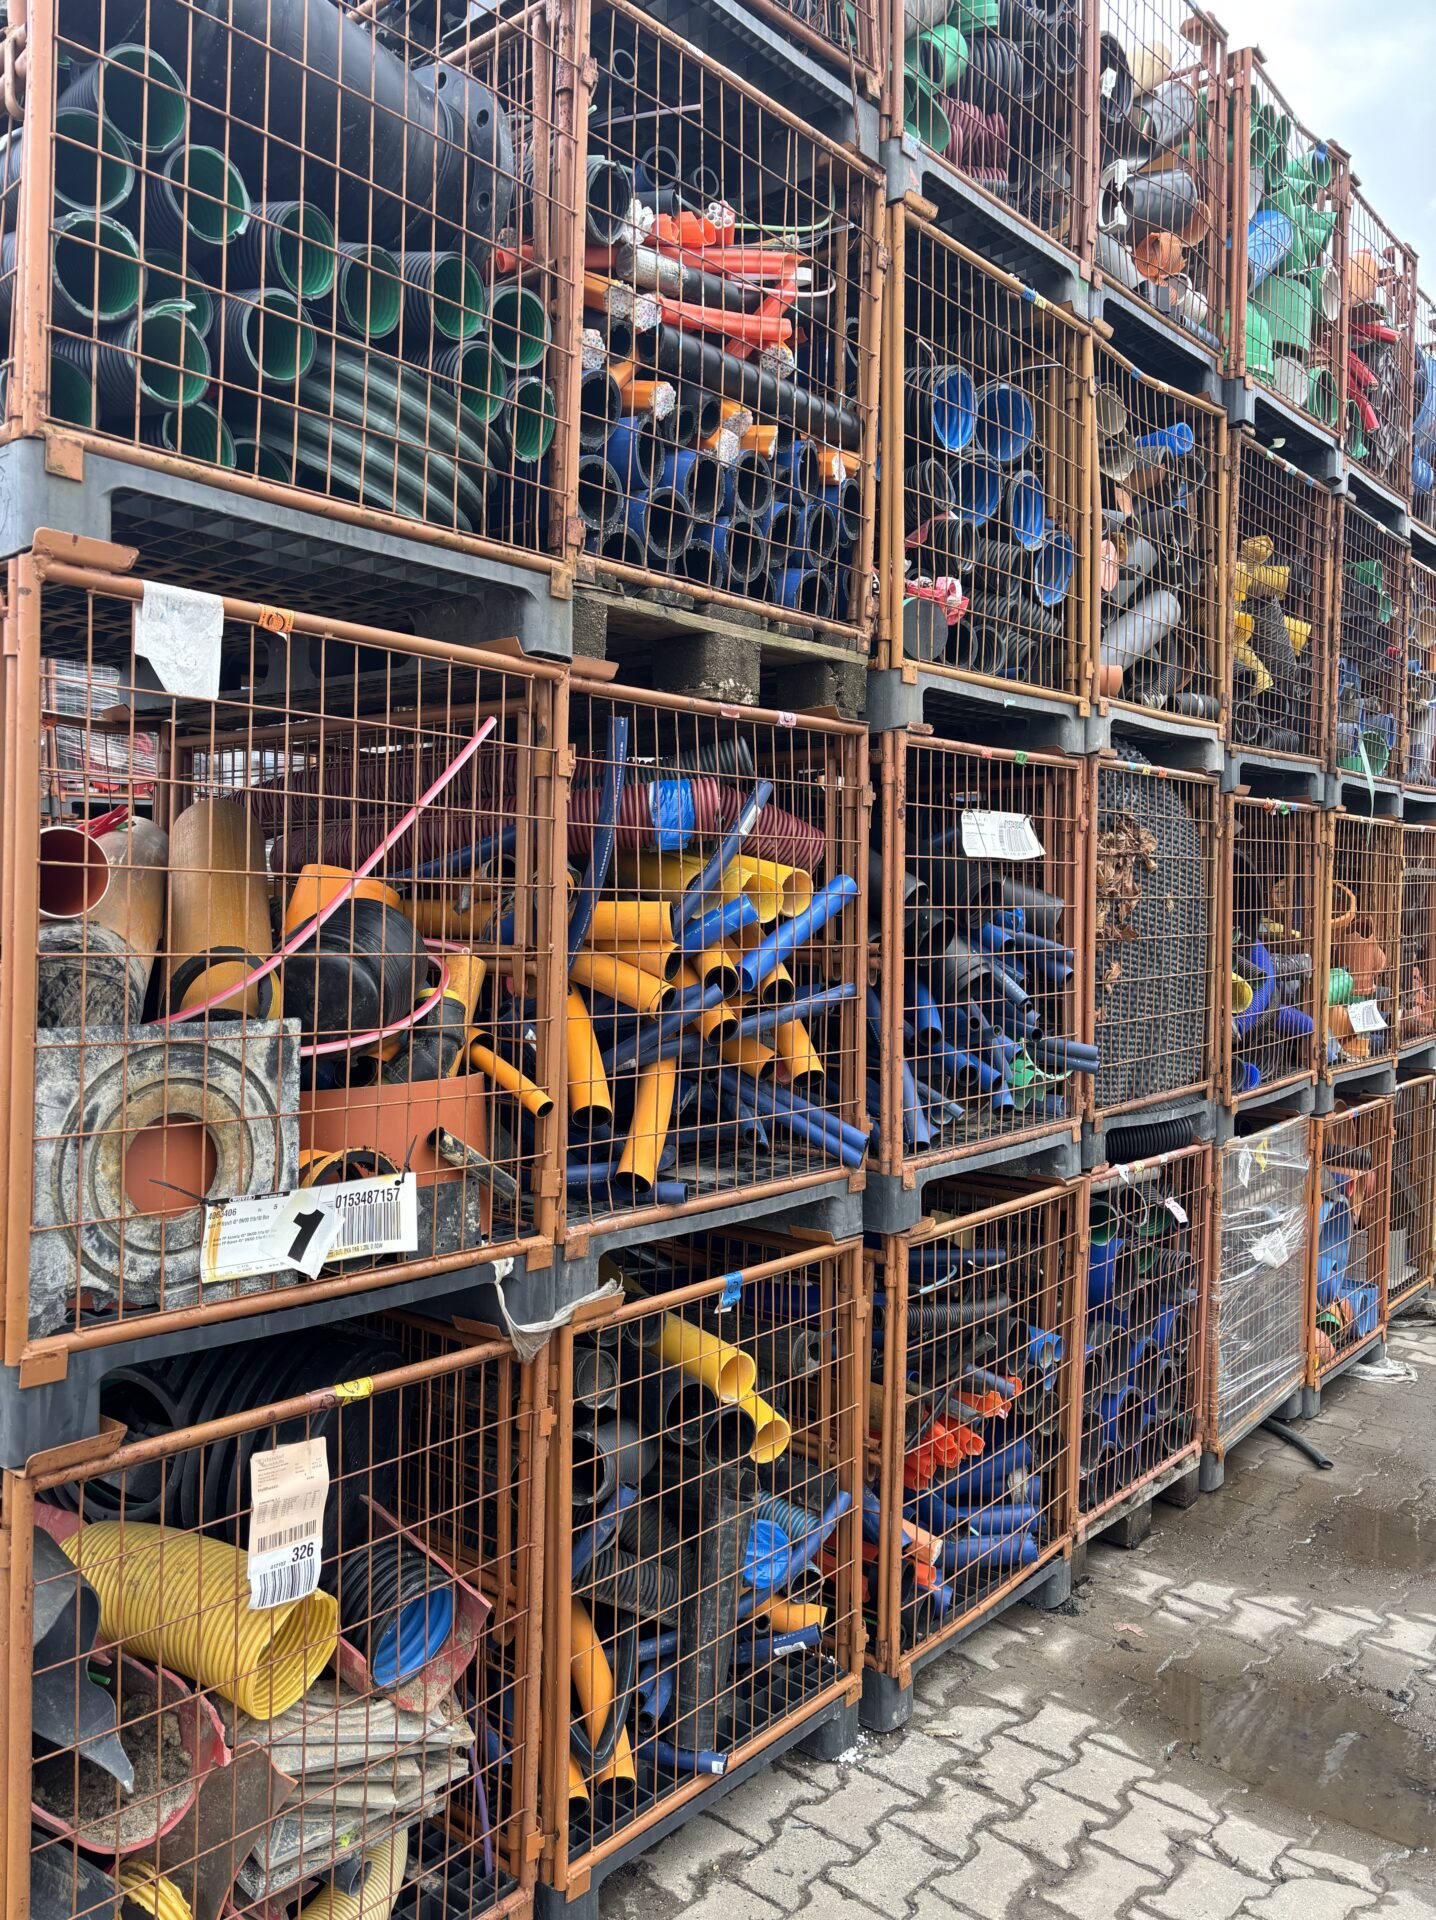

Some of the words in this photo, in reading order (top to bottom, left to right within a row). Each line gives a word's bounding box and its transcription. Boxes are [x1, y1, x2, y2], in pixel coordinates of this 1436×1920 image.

[335, 1188, 400, 1208] 0153487157
[287, 1209, 325, 1262] 1
[292, 1541, 314, 1562] 326
